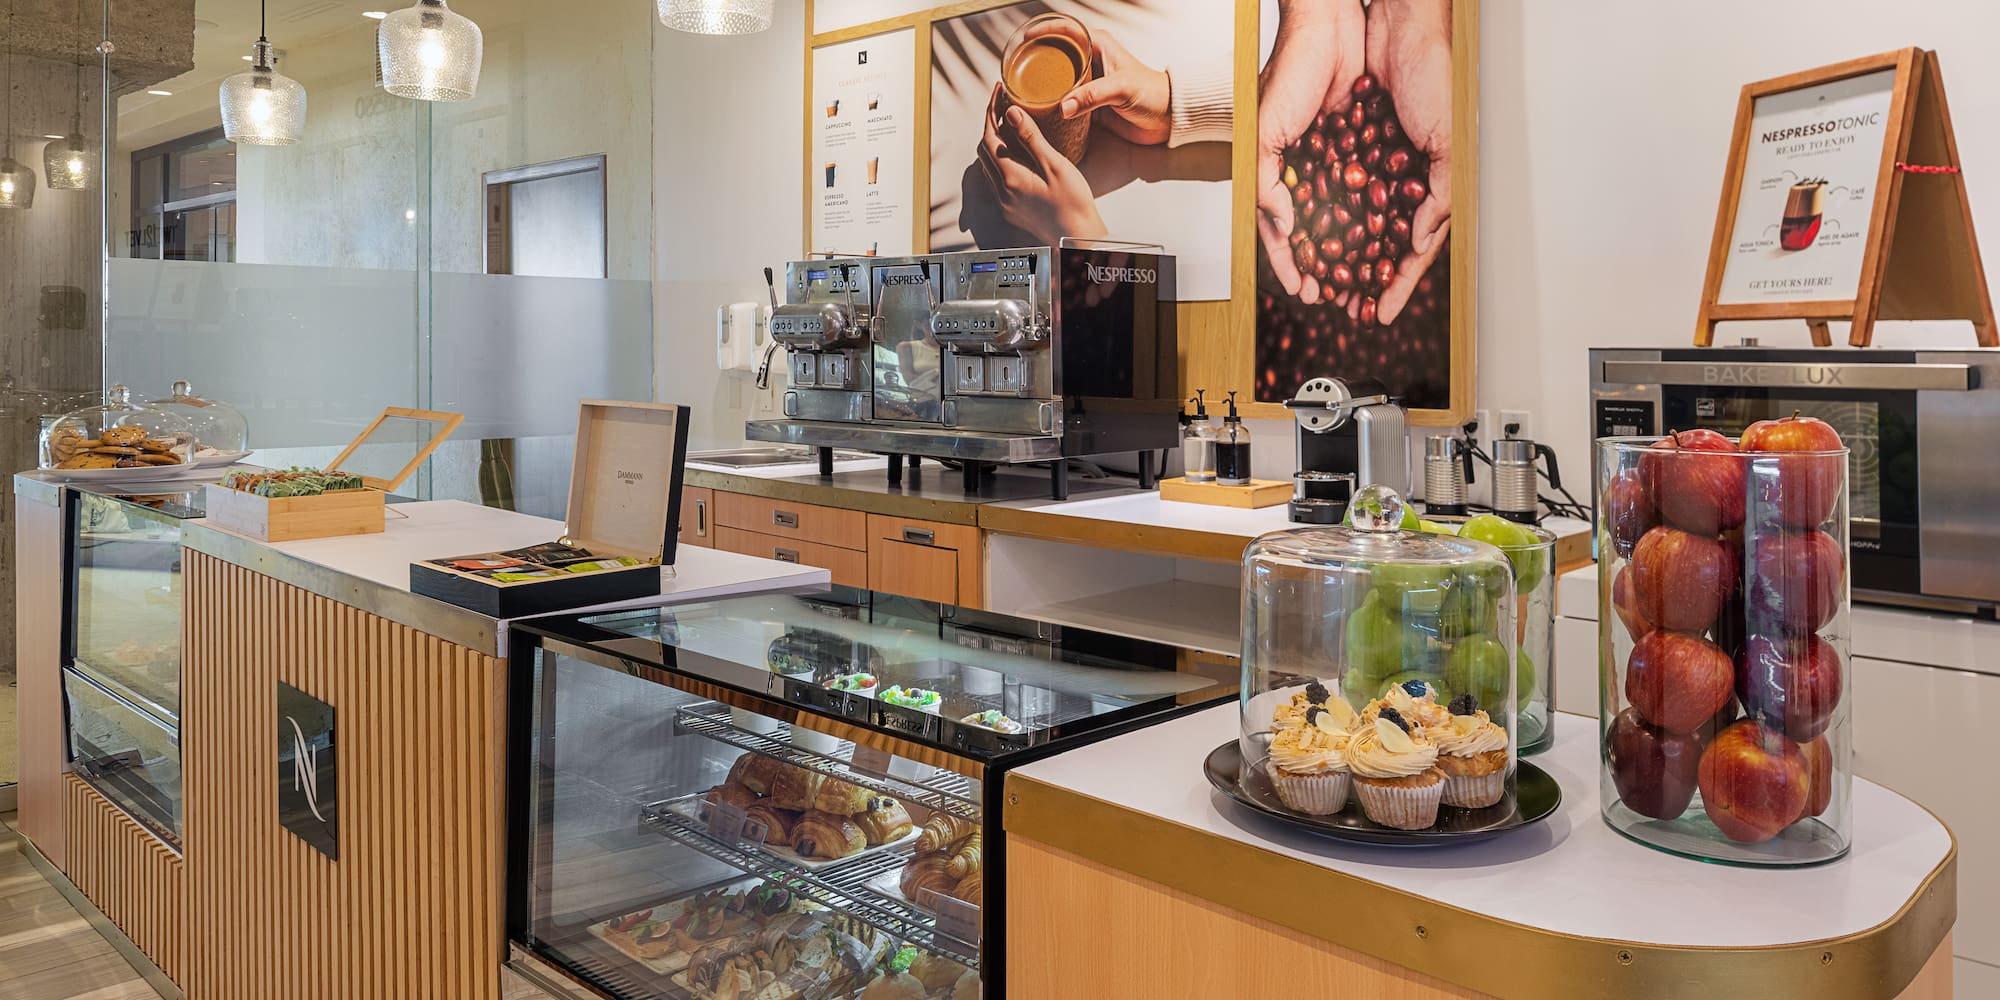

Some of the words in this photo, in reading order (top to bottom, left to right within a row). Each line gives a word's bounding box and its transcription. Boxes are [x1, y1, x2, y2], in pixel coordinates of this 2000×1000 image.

[825, 122, 852, 130] CAPPUCCINO
[1776, 143, 1805, 156] READY
[1809, 140, 1823, 150] TO
[1825, 135, 1856, 148] ENJOY
[882, 273, 925, 287] NESPRESS
[1084, 262, 1157, 285] NESPRESSO
[1749, 279, 1768, 288] GET
[1770, 278, 1802, 288] YOURS
[285, 716, 327, 822] N
